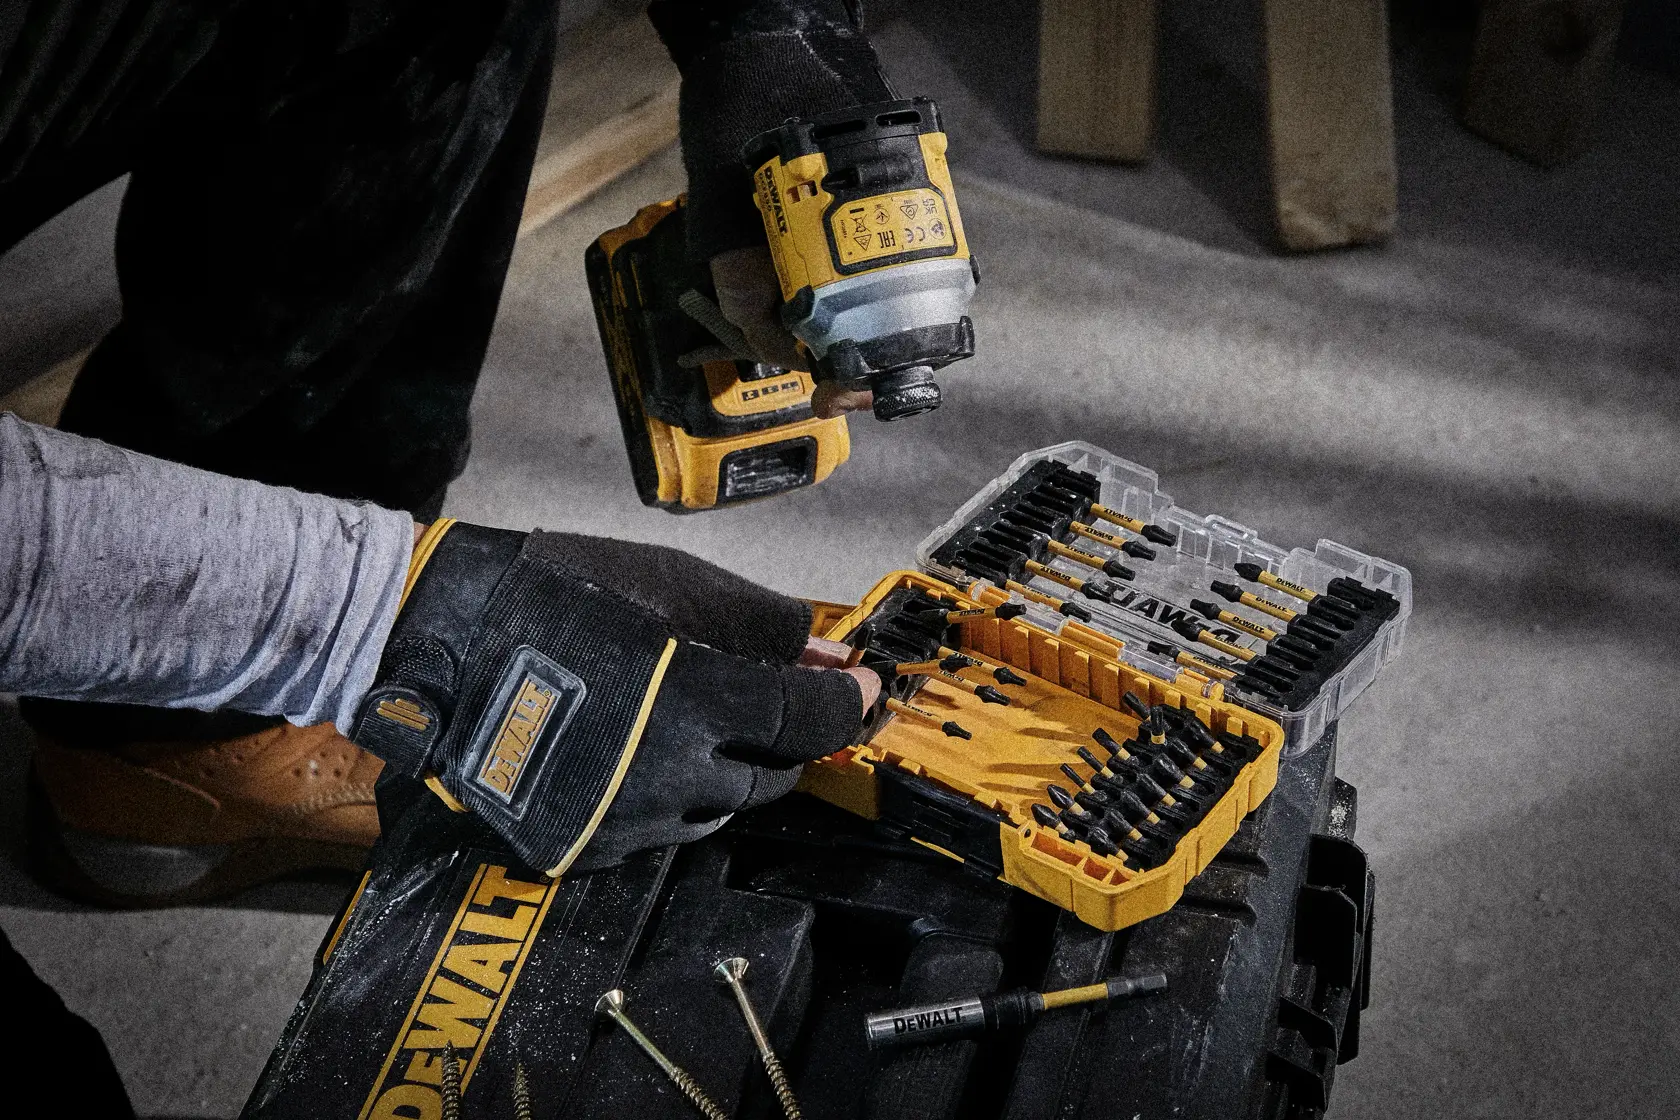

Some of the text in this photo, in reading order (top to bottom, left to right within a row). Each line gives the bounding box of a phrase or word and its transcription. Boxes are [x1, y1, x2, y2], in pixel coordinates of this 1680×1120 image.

[1103, 507, 1133, 523] DEWALT
[1084, 526, 1114, 541] DEWALT
[1040, 565, 1071, 581] DEWALT
[1276, 577, 1305, 592] DEWALT
[1255, 596, 1287, 613] DEWALT
[1232, 616, 1265, 633] DEWALT
[484, 683, 551, 793] DEWALT
[892, 1006, 964, 1034] DEWALT
